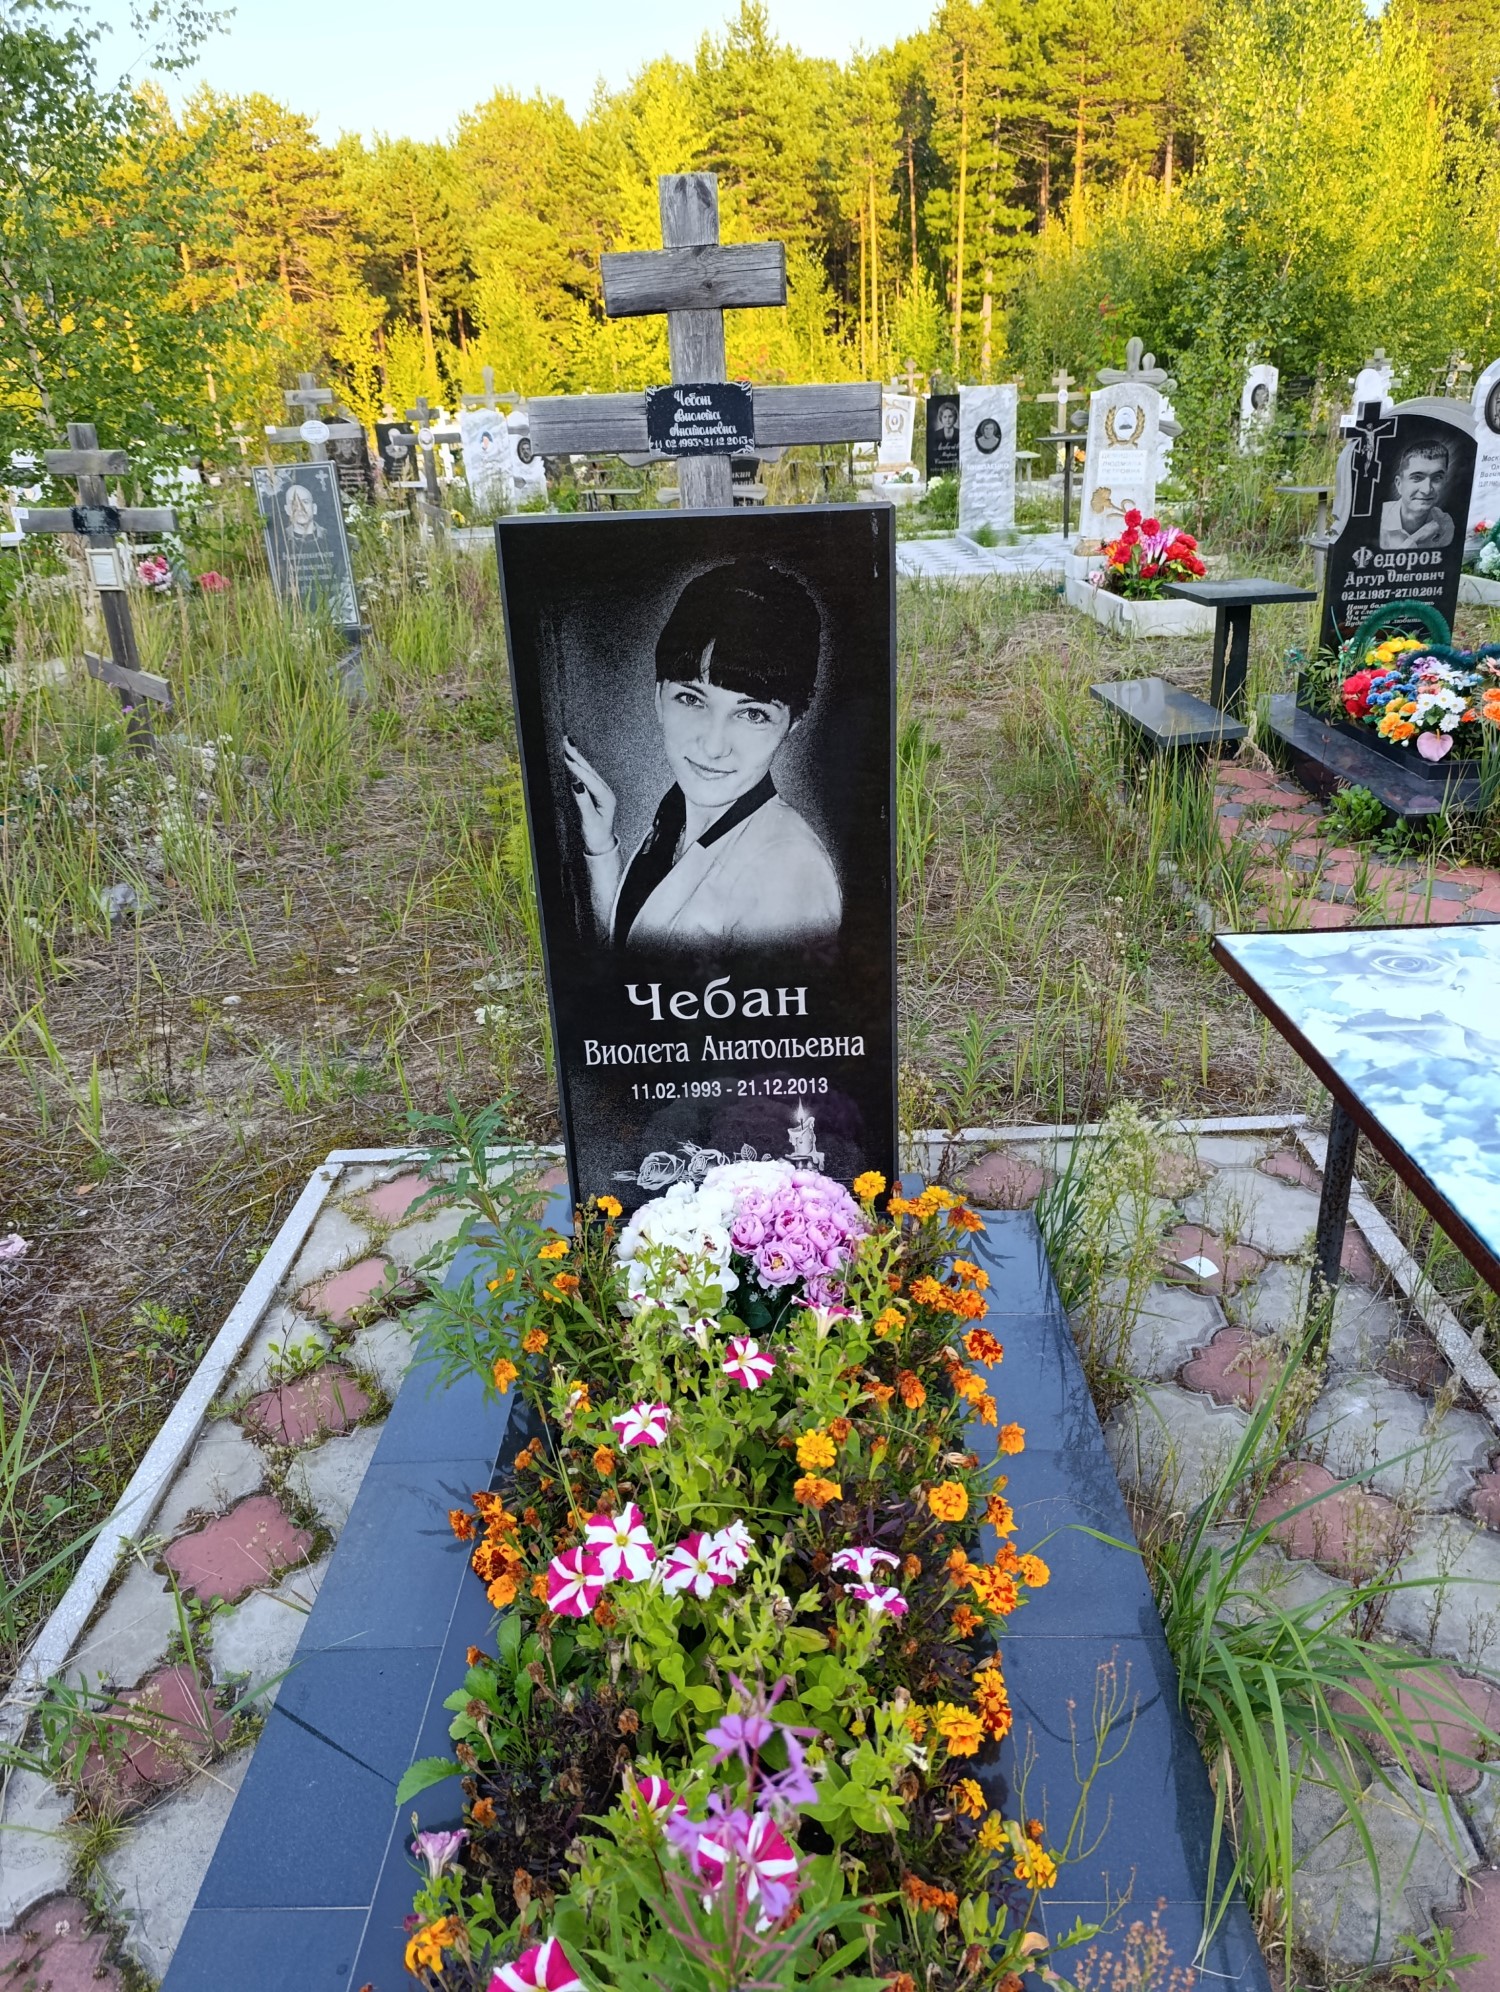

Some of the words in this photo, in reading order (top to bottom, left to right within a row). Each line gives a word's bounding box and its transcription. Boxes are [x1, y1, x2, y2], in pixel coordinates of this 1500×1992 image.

[1481, 454, 1500, 462] Моск
[1352, 546, 1443, 571] Федоров
[1343, 571, 1385, 588] Артур
[1386, 569, 1445, 583] Олегович
[624, 975, 809, 1021] Чебан
[584, 1039, 690, 1066] Виолета
[701, 1034, 865, 1061] Анатольевна
[631, 1081, 722, 1100] 11.02.1993
[737, 1077, 828, 1097] 21.12.2013
